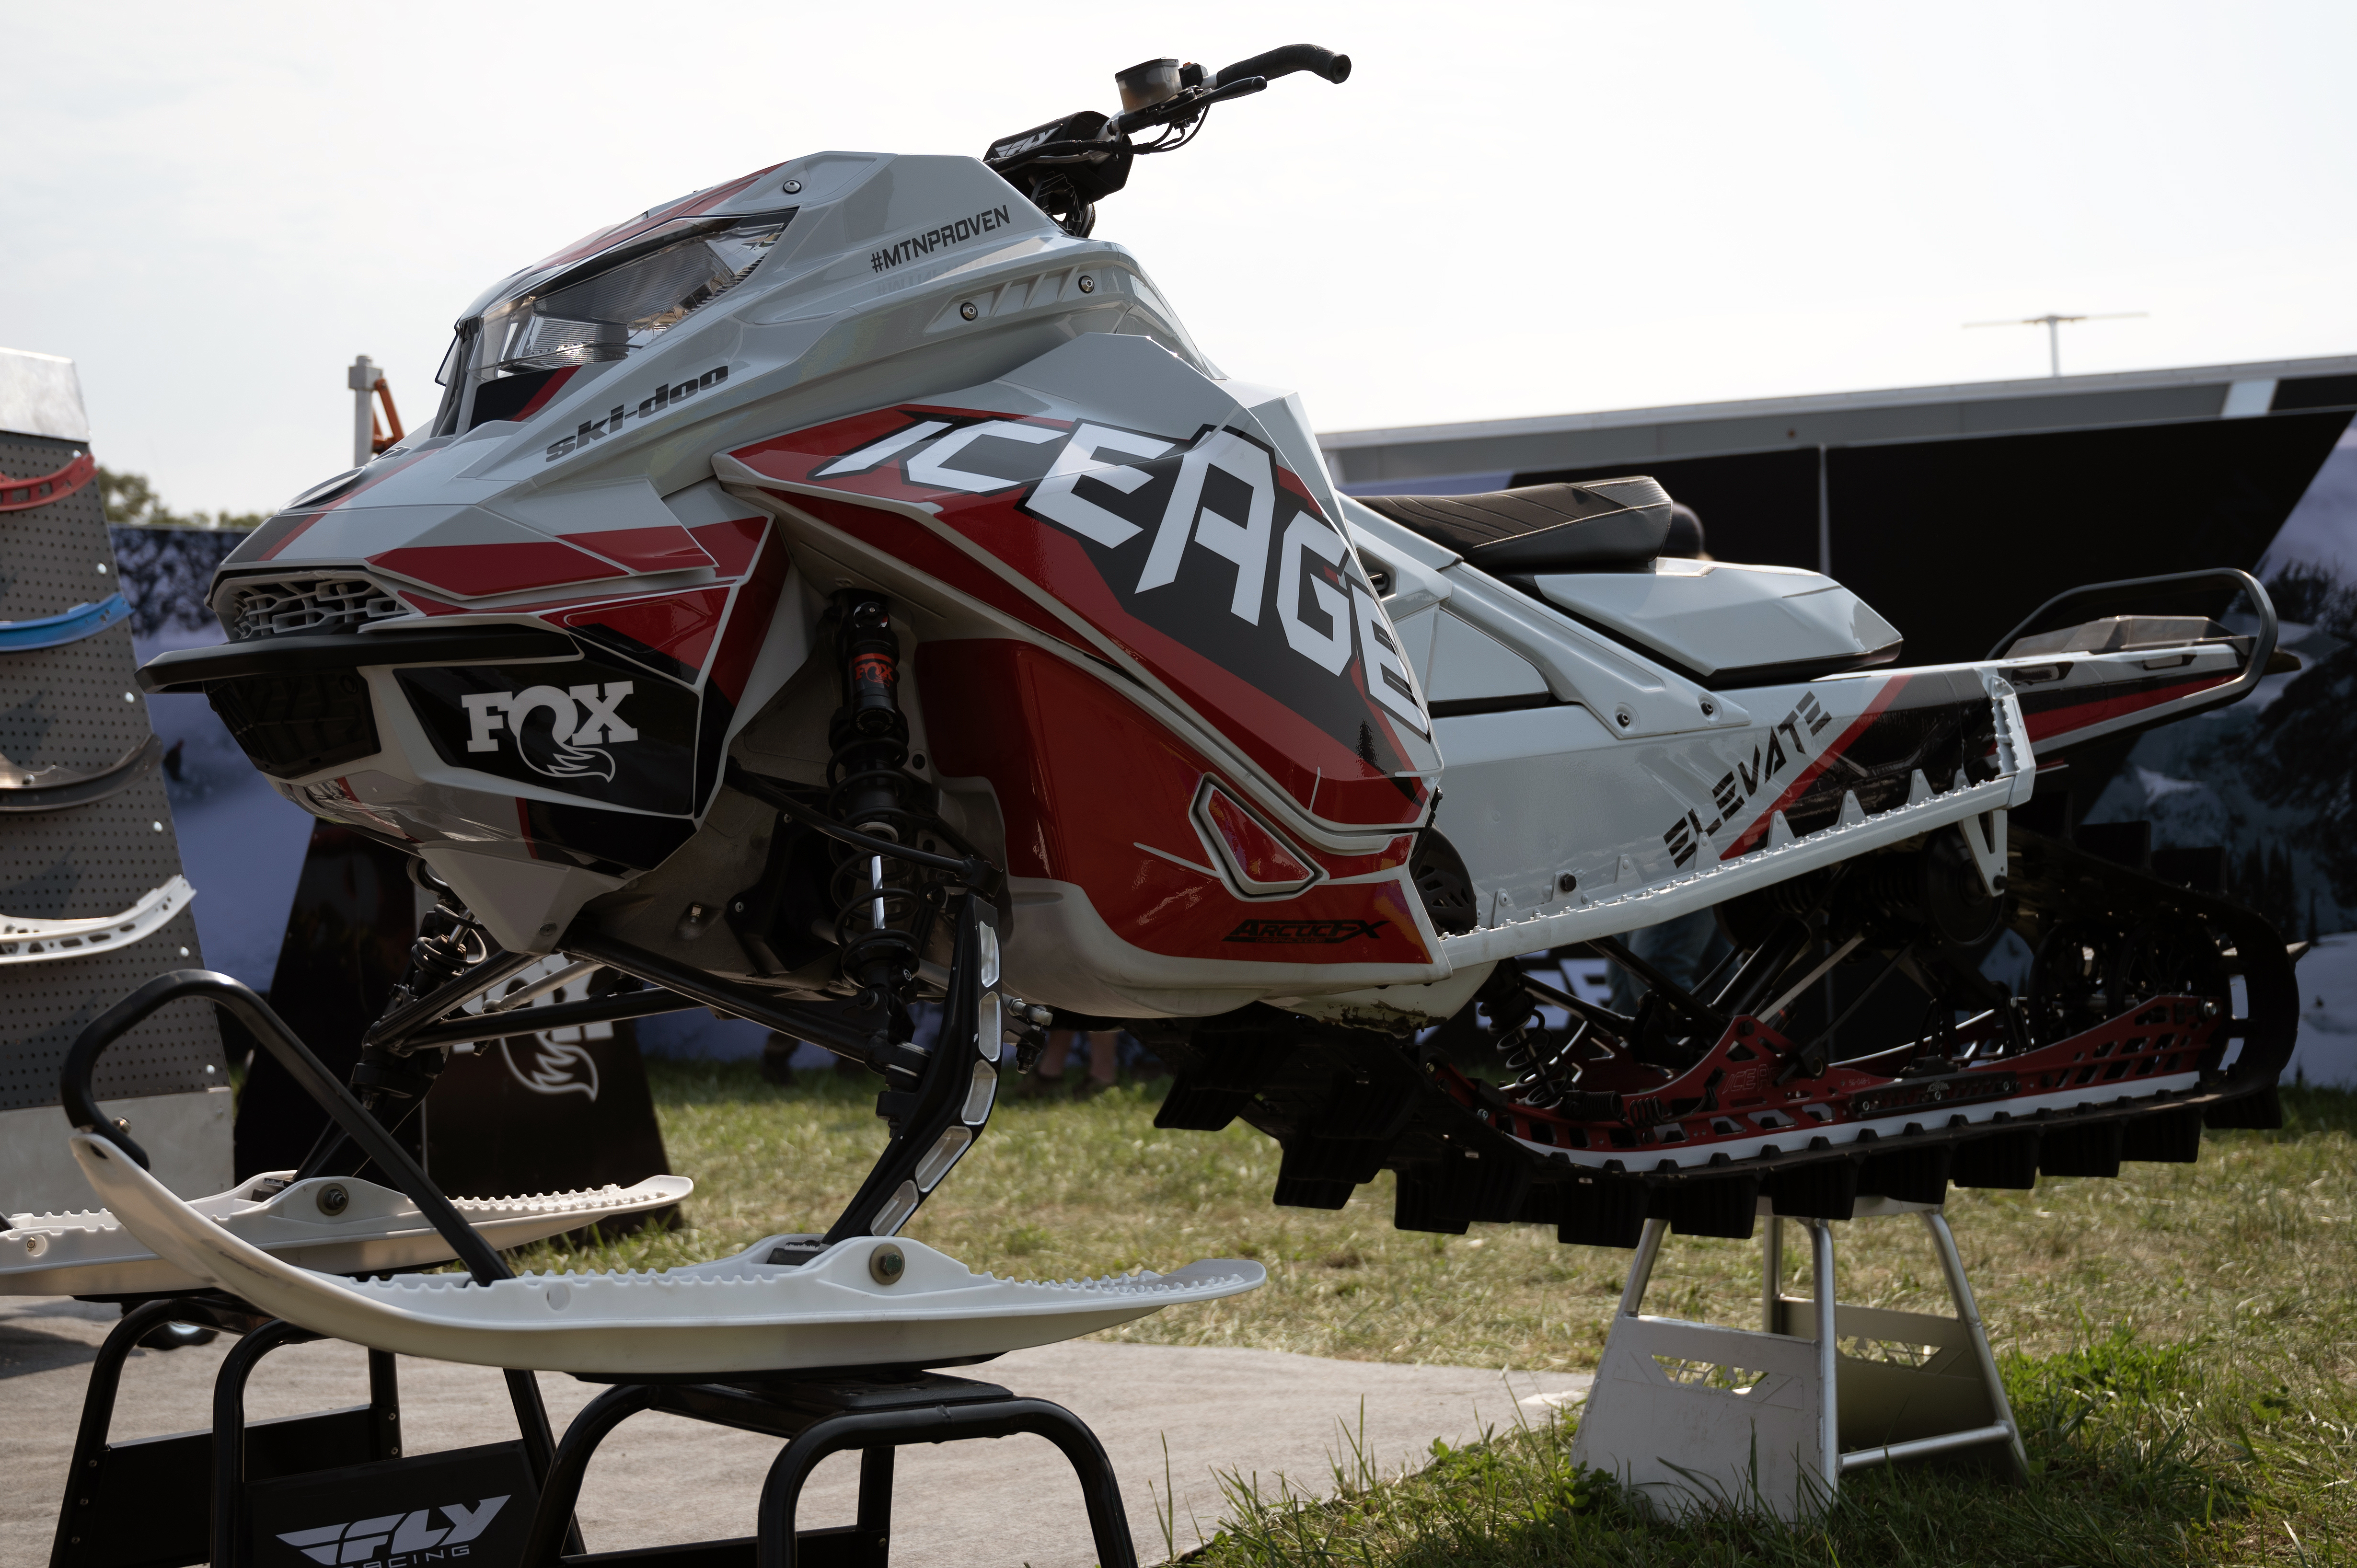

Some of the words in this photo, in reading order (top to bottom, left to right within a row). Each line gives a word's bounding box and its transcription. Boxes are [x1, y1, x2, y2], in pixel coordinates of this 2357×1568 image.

[995, 127, 1060, 157] FLY
[871, 205, 1010, 273] #MTNPROVEN
[546, 366, 728, 462] ski-doo
[855, 662, 893, 687] FOX
[461, 681, 638, 782] FOX
[1664, 691, 1832, 868] ELEVATE
[276, 1495, 511, 1565] FLY
[338, 1545, 470, 1568] ACING
